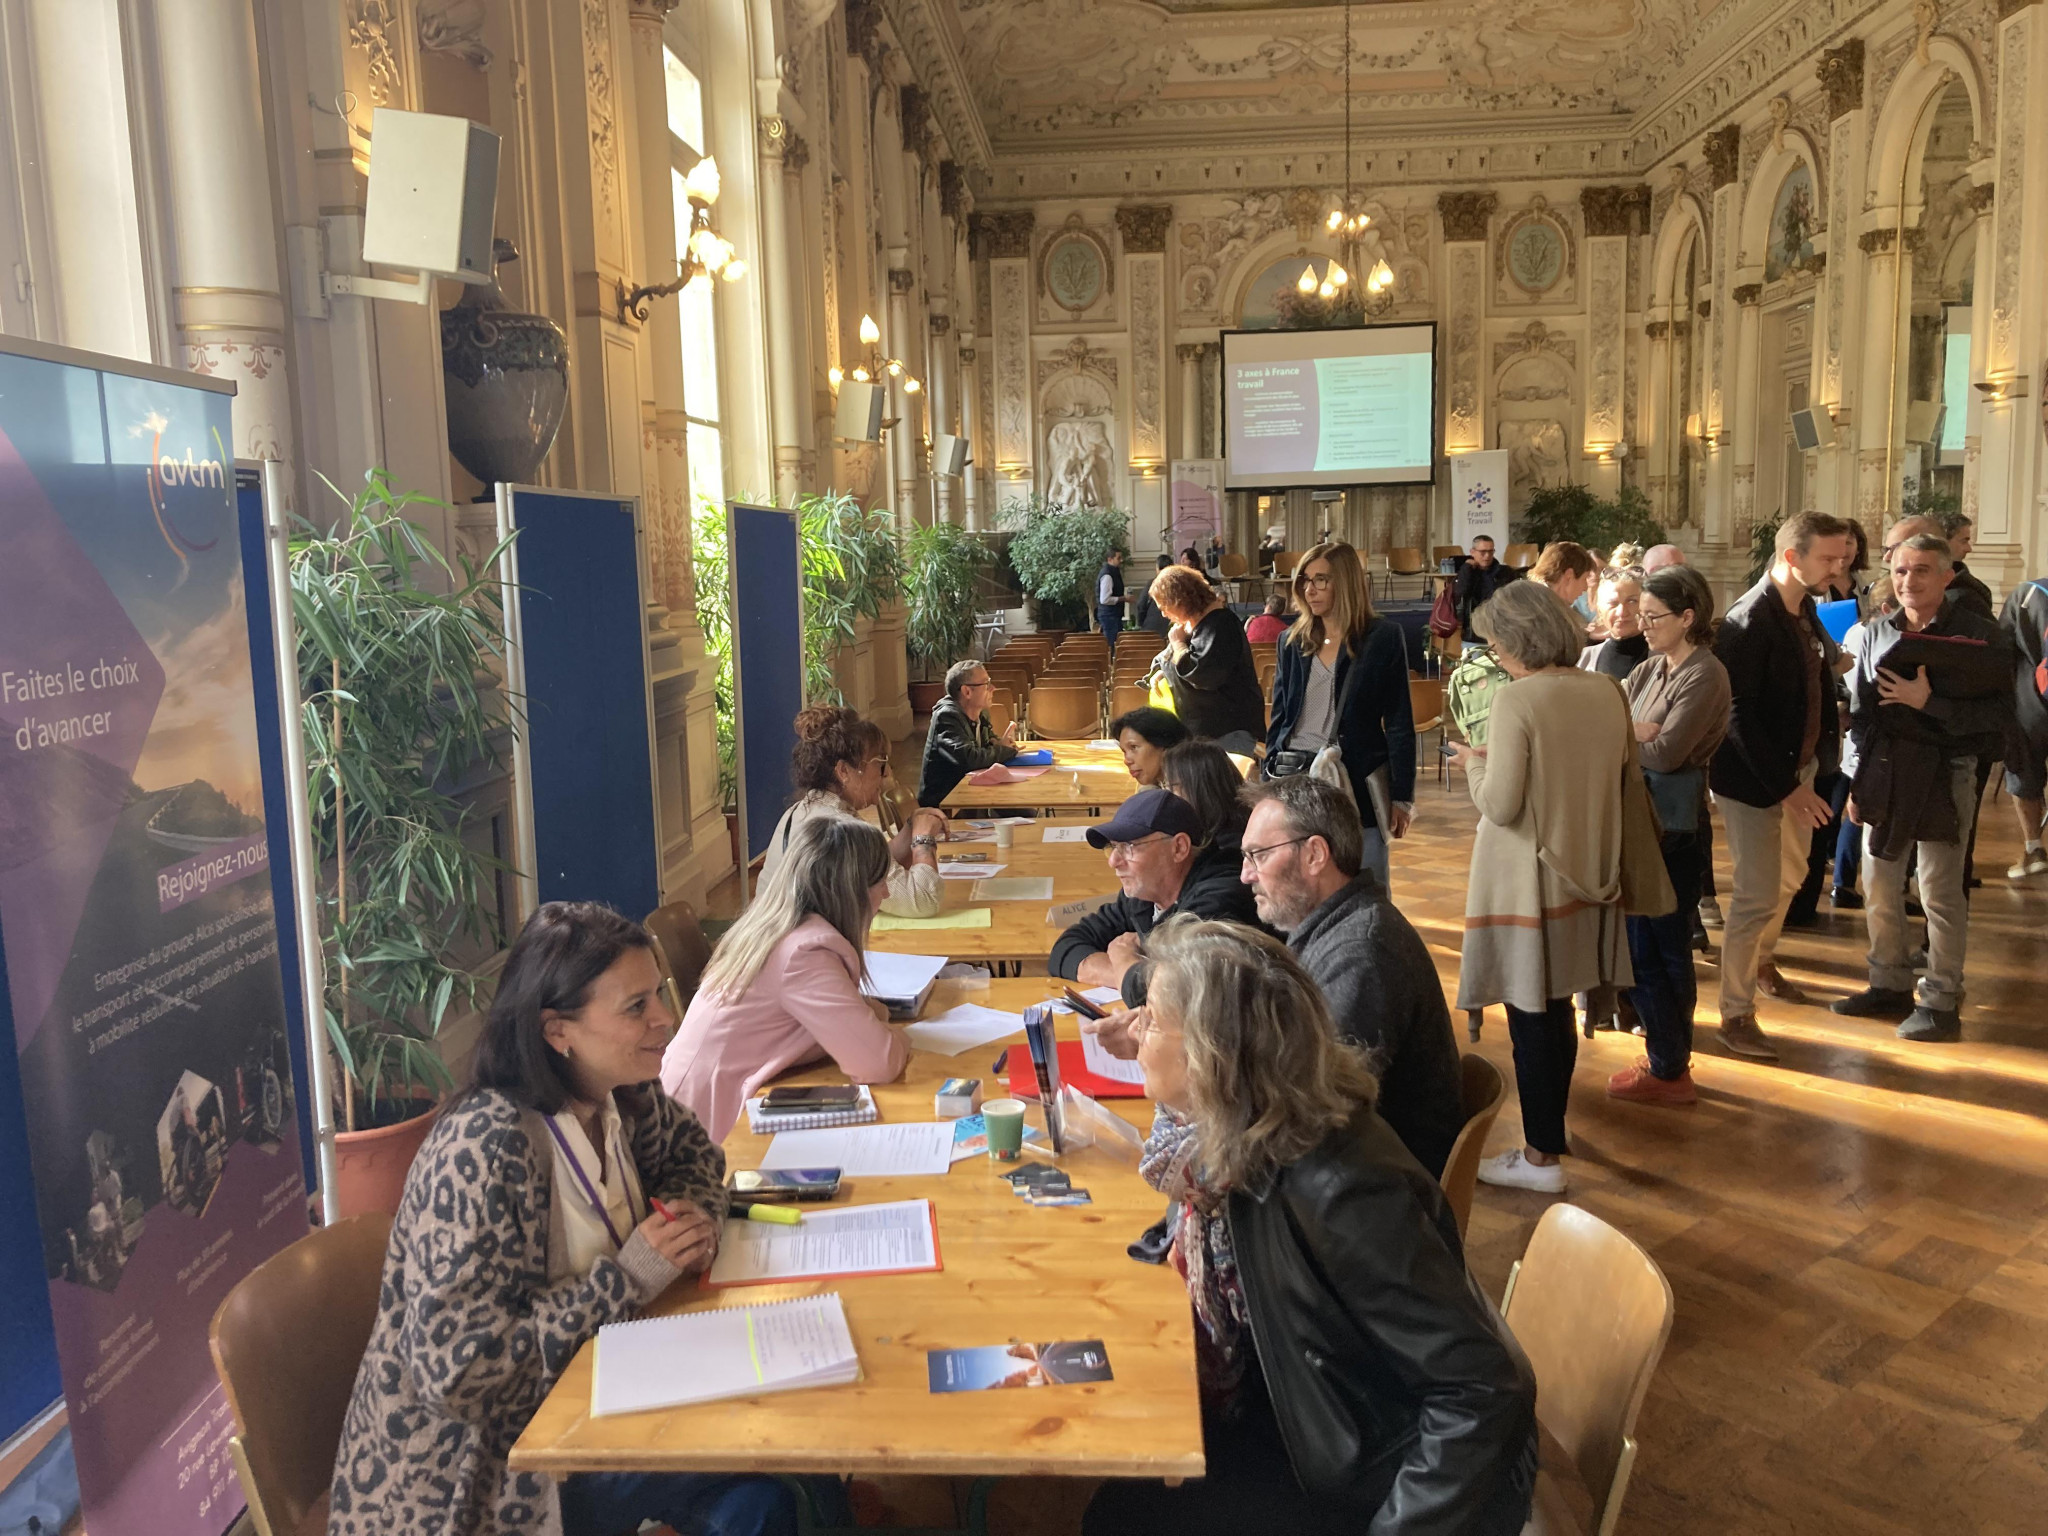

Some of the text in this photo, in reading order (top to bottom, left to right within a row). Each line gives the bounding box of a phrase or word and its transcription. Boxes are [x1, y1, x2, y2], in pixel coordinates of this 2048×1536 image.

[1237, 367, 1300, 378] 3 axes à France
[1237, 379, 1264, 389] travail
[1467, 517, 1493, 525] Travail
[1, 656, 140, 704] Faites le choix
[15, 711, 112, 751] d'avancer
[157, 839, 269, 904] Rejoignez-nous
[1062, 902, 1087, 916] ALYCE
[94, 956, 148, 992] Entreprise
[147, 947, 162, 969] du
[161, 933, 195, 963] groupe
[83, 990, 131, 1028] transport
[178, 1465, 191, 1490] 20
